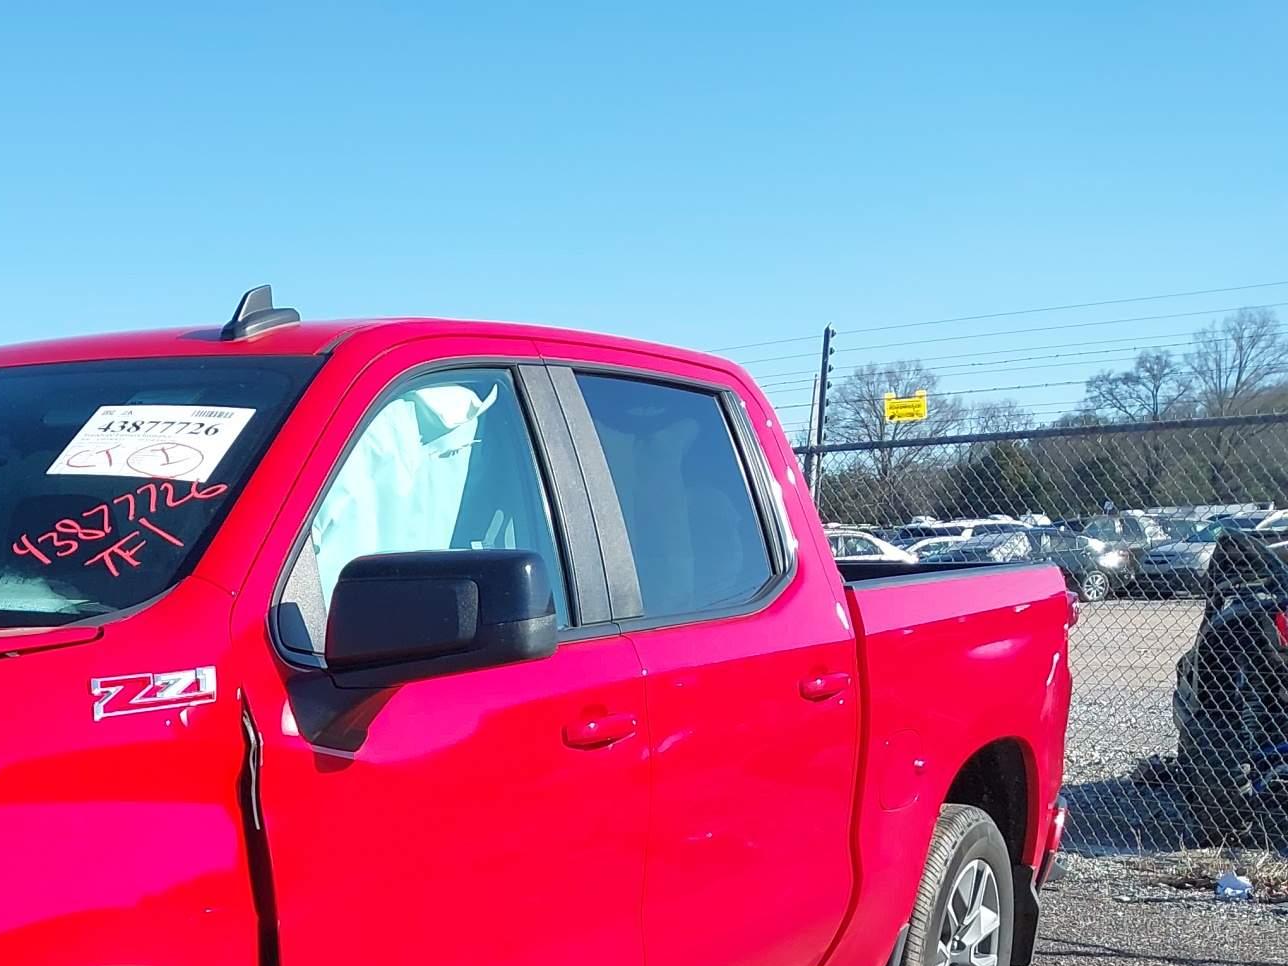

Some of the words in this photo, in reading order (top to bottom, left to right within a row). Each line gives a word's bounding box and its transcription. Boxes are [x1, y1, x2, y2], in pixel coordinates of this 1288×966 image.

[97, 418, 222, 437] 43877726
[11, 479, 230, 565] 43877726
[90, 665, 218, 722] Z71
